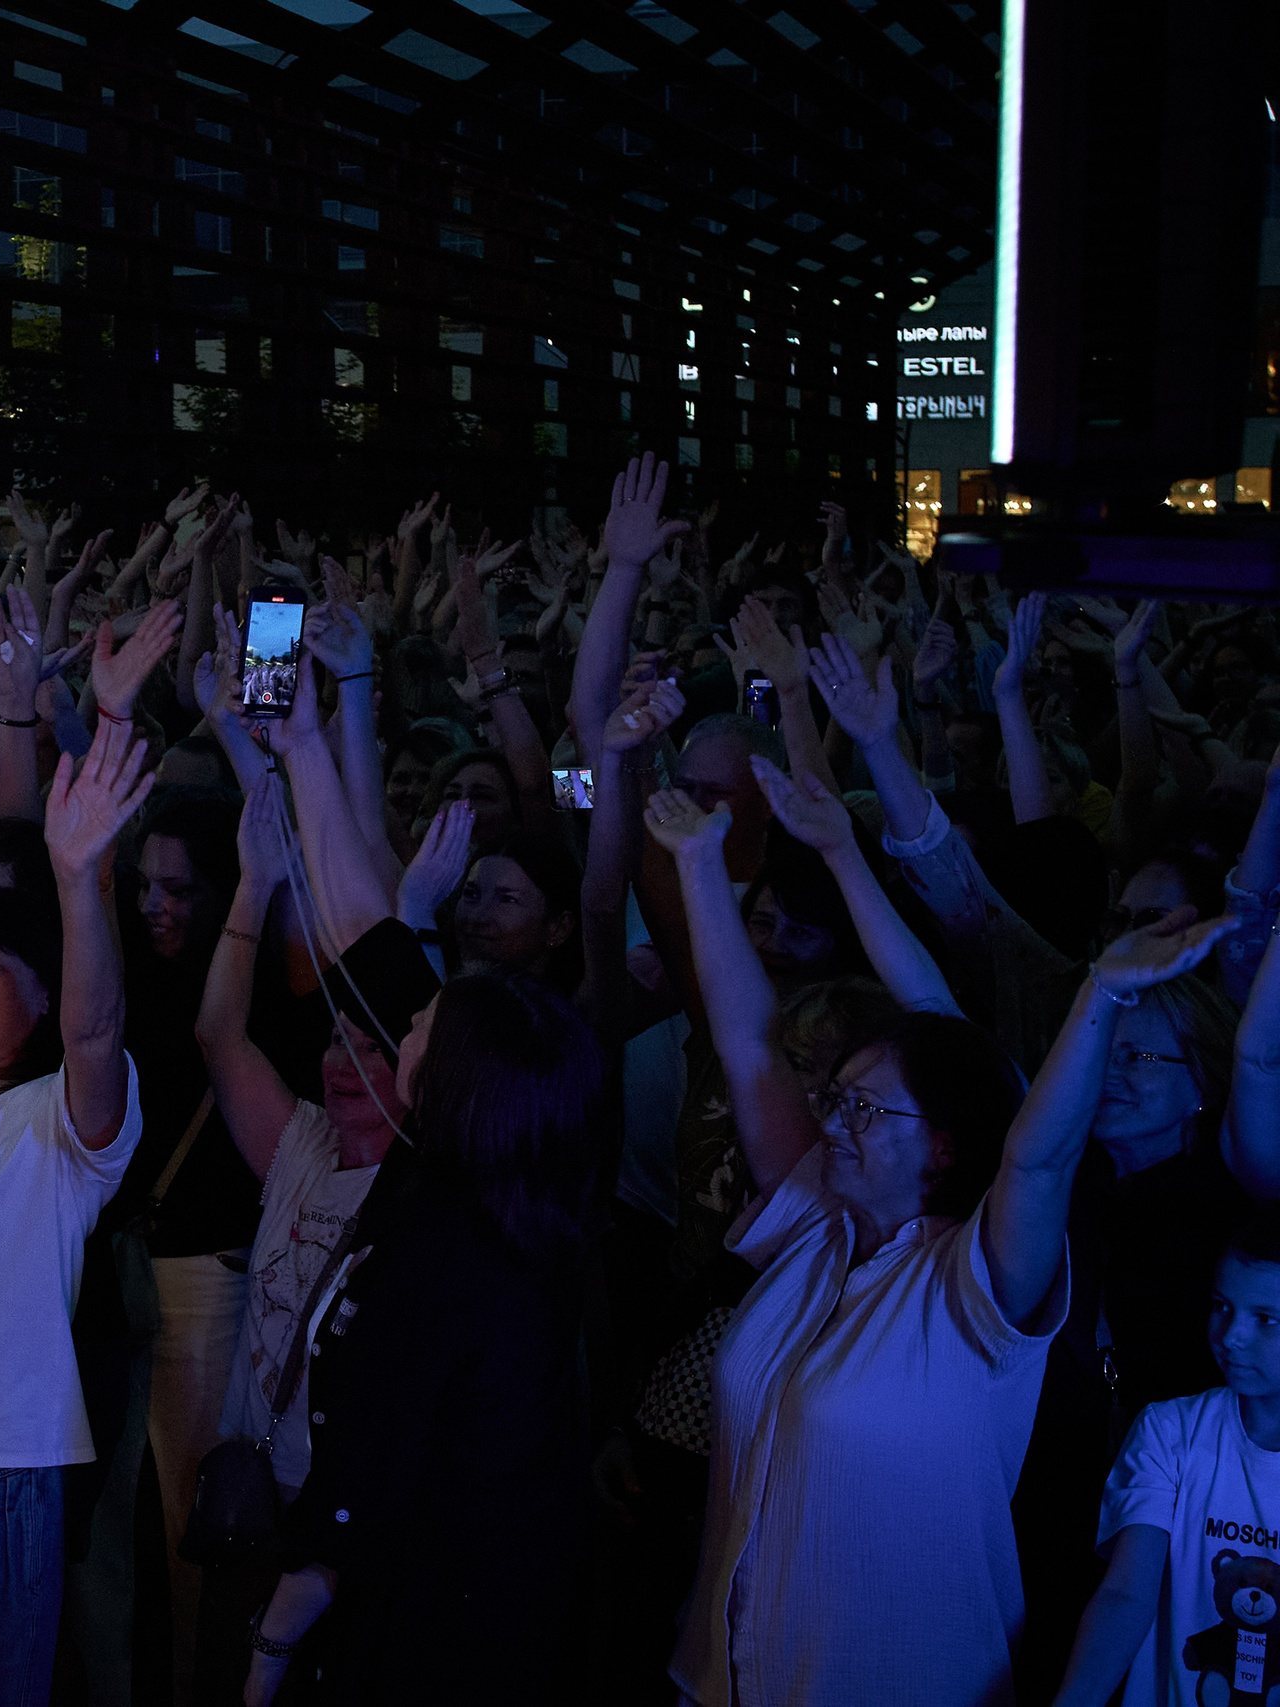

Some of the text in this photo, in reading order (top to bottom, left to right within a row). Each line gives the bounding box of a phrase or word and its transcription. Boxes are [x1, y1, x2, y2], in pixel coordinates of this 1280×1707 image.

[940, 326, 987, 341] лапы
[903, 356, 985, 377] ESTEL
[1205, 1517, 1280, 1550] MOSCH
[1244, 1634, 1253, 1645] IS
[1240, 1670, 1258, 1681] TOY
